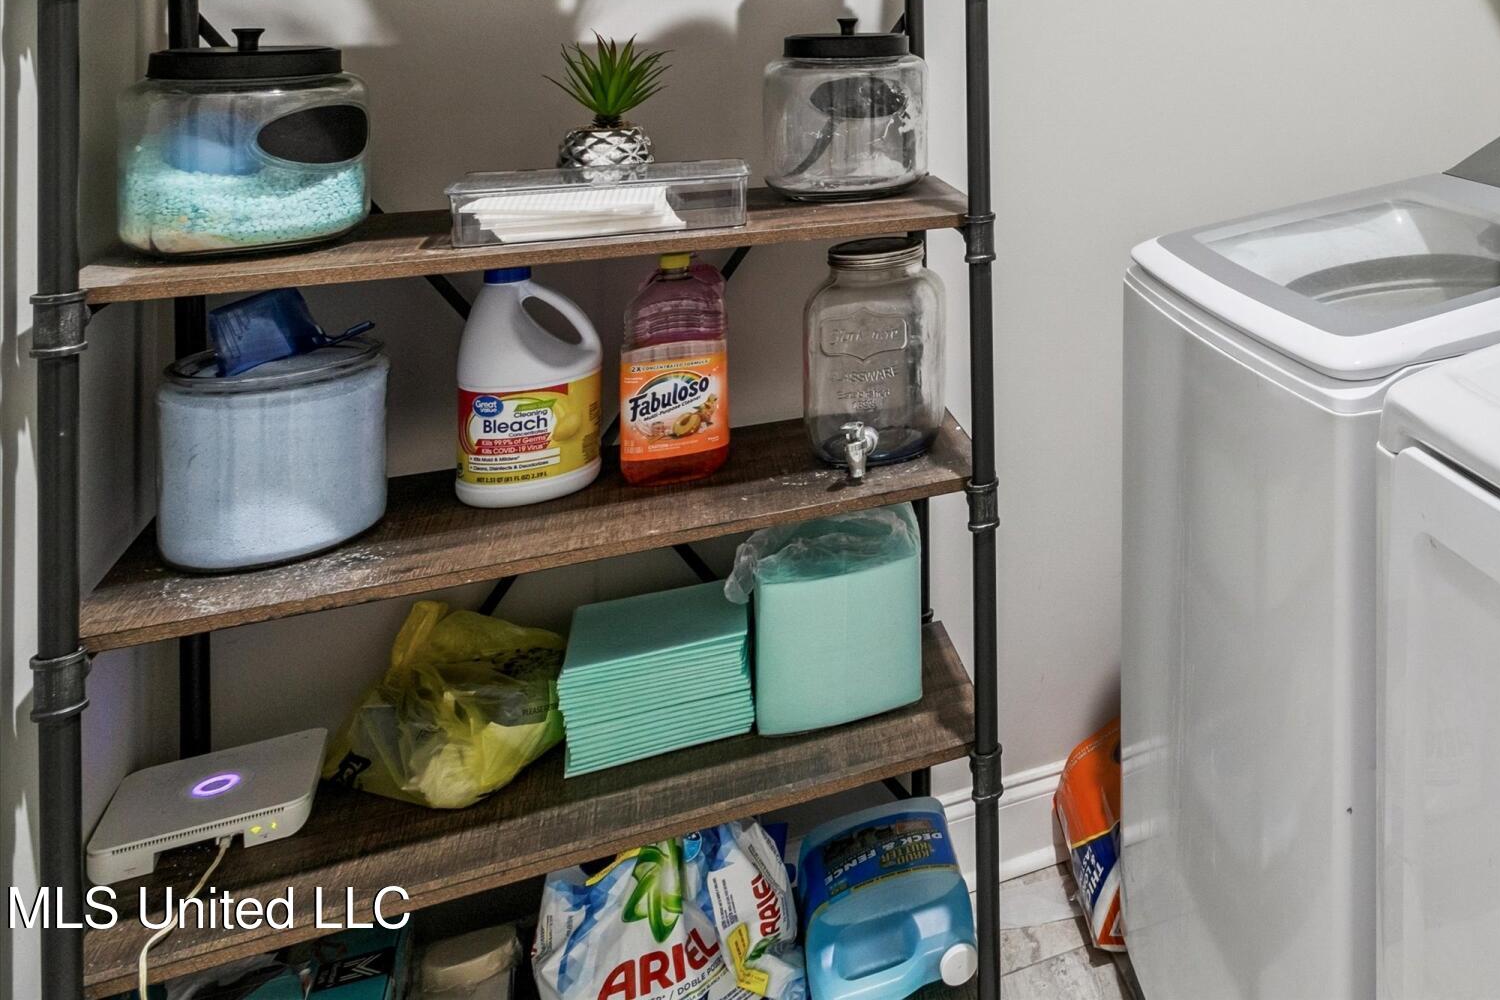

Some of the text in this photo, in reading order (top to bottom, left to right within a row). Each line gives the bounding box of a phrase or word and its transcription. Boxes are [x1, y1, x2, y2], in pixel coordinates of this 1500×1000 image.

[475, 400, 498, 409] Great
[629, 376, 710, 422] Fabuloso
[513, 409, 548, 419] Cleaning
[483, 416, 548, 434] Bleach
[508, 429, 549, 438] Concentrated
[493, 445, 526, 455] COVID-19
[881, 842, 896, 850] &
[902, 831, 944, 846] DECK
[824, 849, 878, 886] FENCE
[597, 928, 721, 1000] ARIEL
[677, 971, 706, 997] DOBLE
